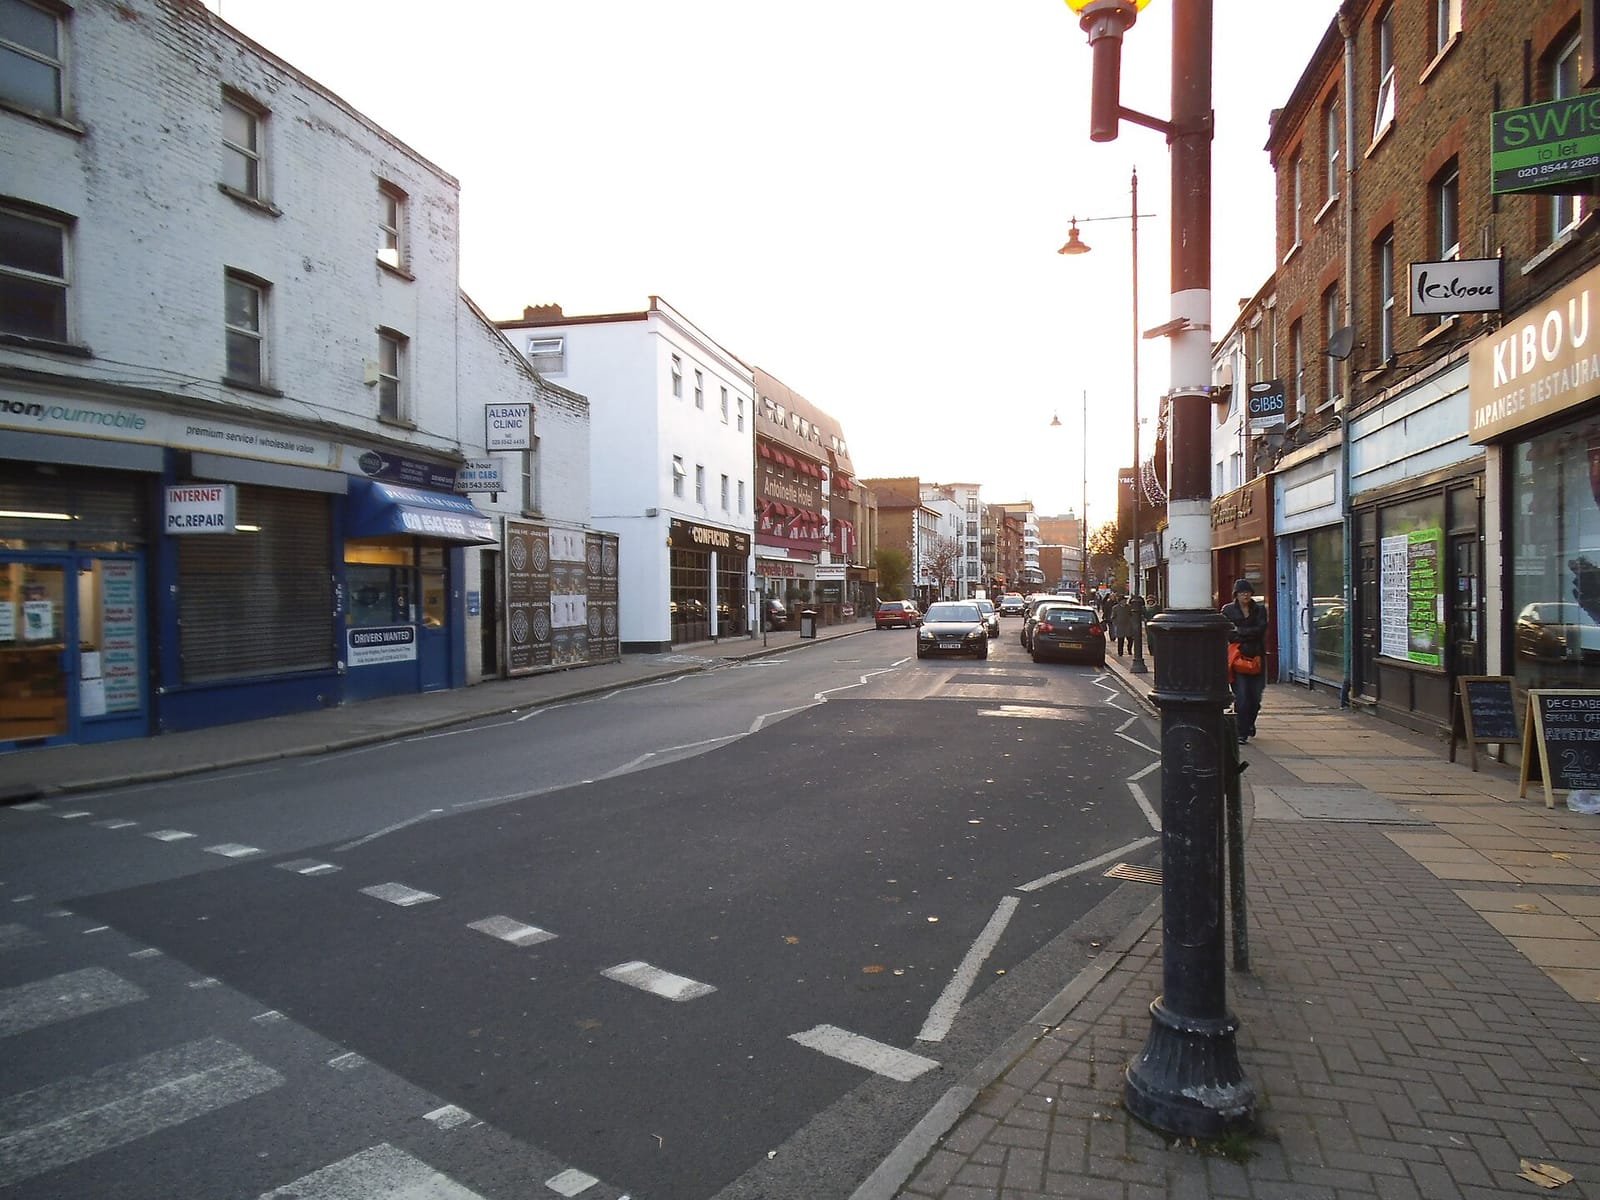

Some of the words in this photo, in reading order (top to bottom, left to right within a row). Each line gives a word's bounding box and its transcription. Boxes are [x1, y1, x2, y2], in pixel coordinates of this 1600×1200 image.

[1538, 149, 1553, 161] to
[1558, 142, 1578, 157] let
[1518, 167, 1538, 178] 020
[1540, 161, 1568, 173] 8544
[1571, 156, 1600, 169] 2828
[1493, 290, 1590, 389] KIBOU
[1473, 388, 1526, 430] JAPANESE
[1530, 353, 1600, 405] RESTAURA
[1250, 394, 1284, 412] GIBBS
[489, 408, 528, 418] ALBANY
[493, 420, 523, 429] CLINIC
[186, 425, 224, 439] premium
[225, 430, 254, 444] service
[259, 437, 295, 451] wholesale
[296, 444, 315, 454] value
[460, 471, 476, 479] MINI
[478, 471, 497, 479] CABS
[483, 481, 501, 489] 5555
[764, 476, 798, 502] Antoinette
[798, 487, 813, 507] Hotel
[169, 488, 222, 502] INTERNET
[168, 513, 224, 527] PC.REPAIR
[402, 511, 422, 531] 020
[693, 526, 730, 547] CONFUCIUS
[354, 632, 382, 643] DRIVERS
[383, 630, 409, 642] WANTED
[1545, 713, 1579, 722] SPECIAL
